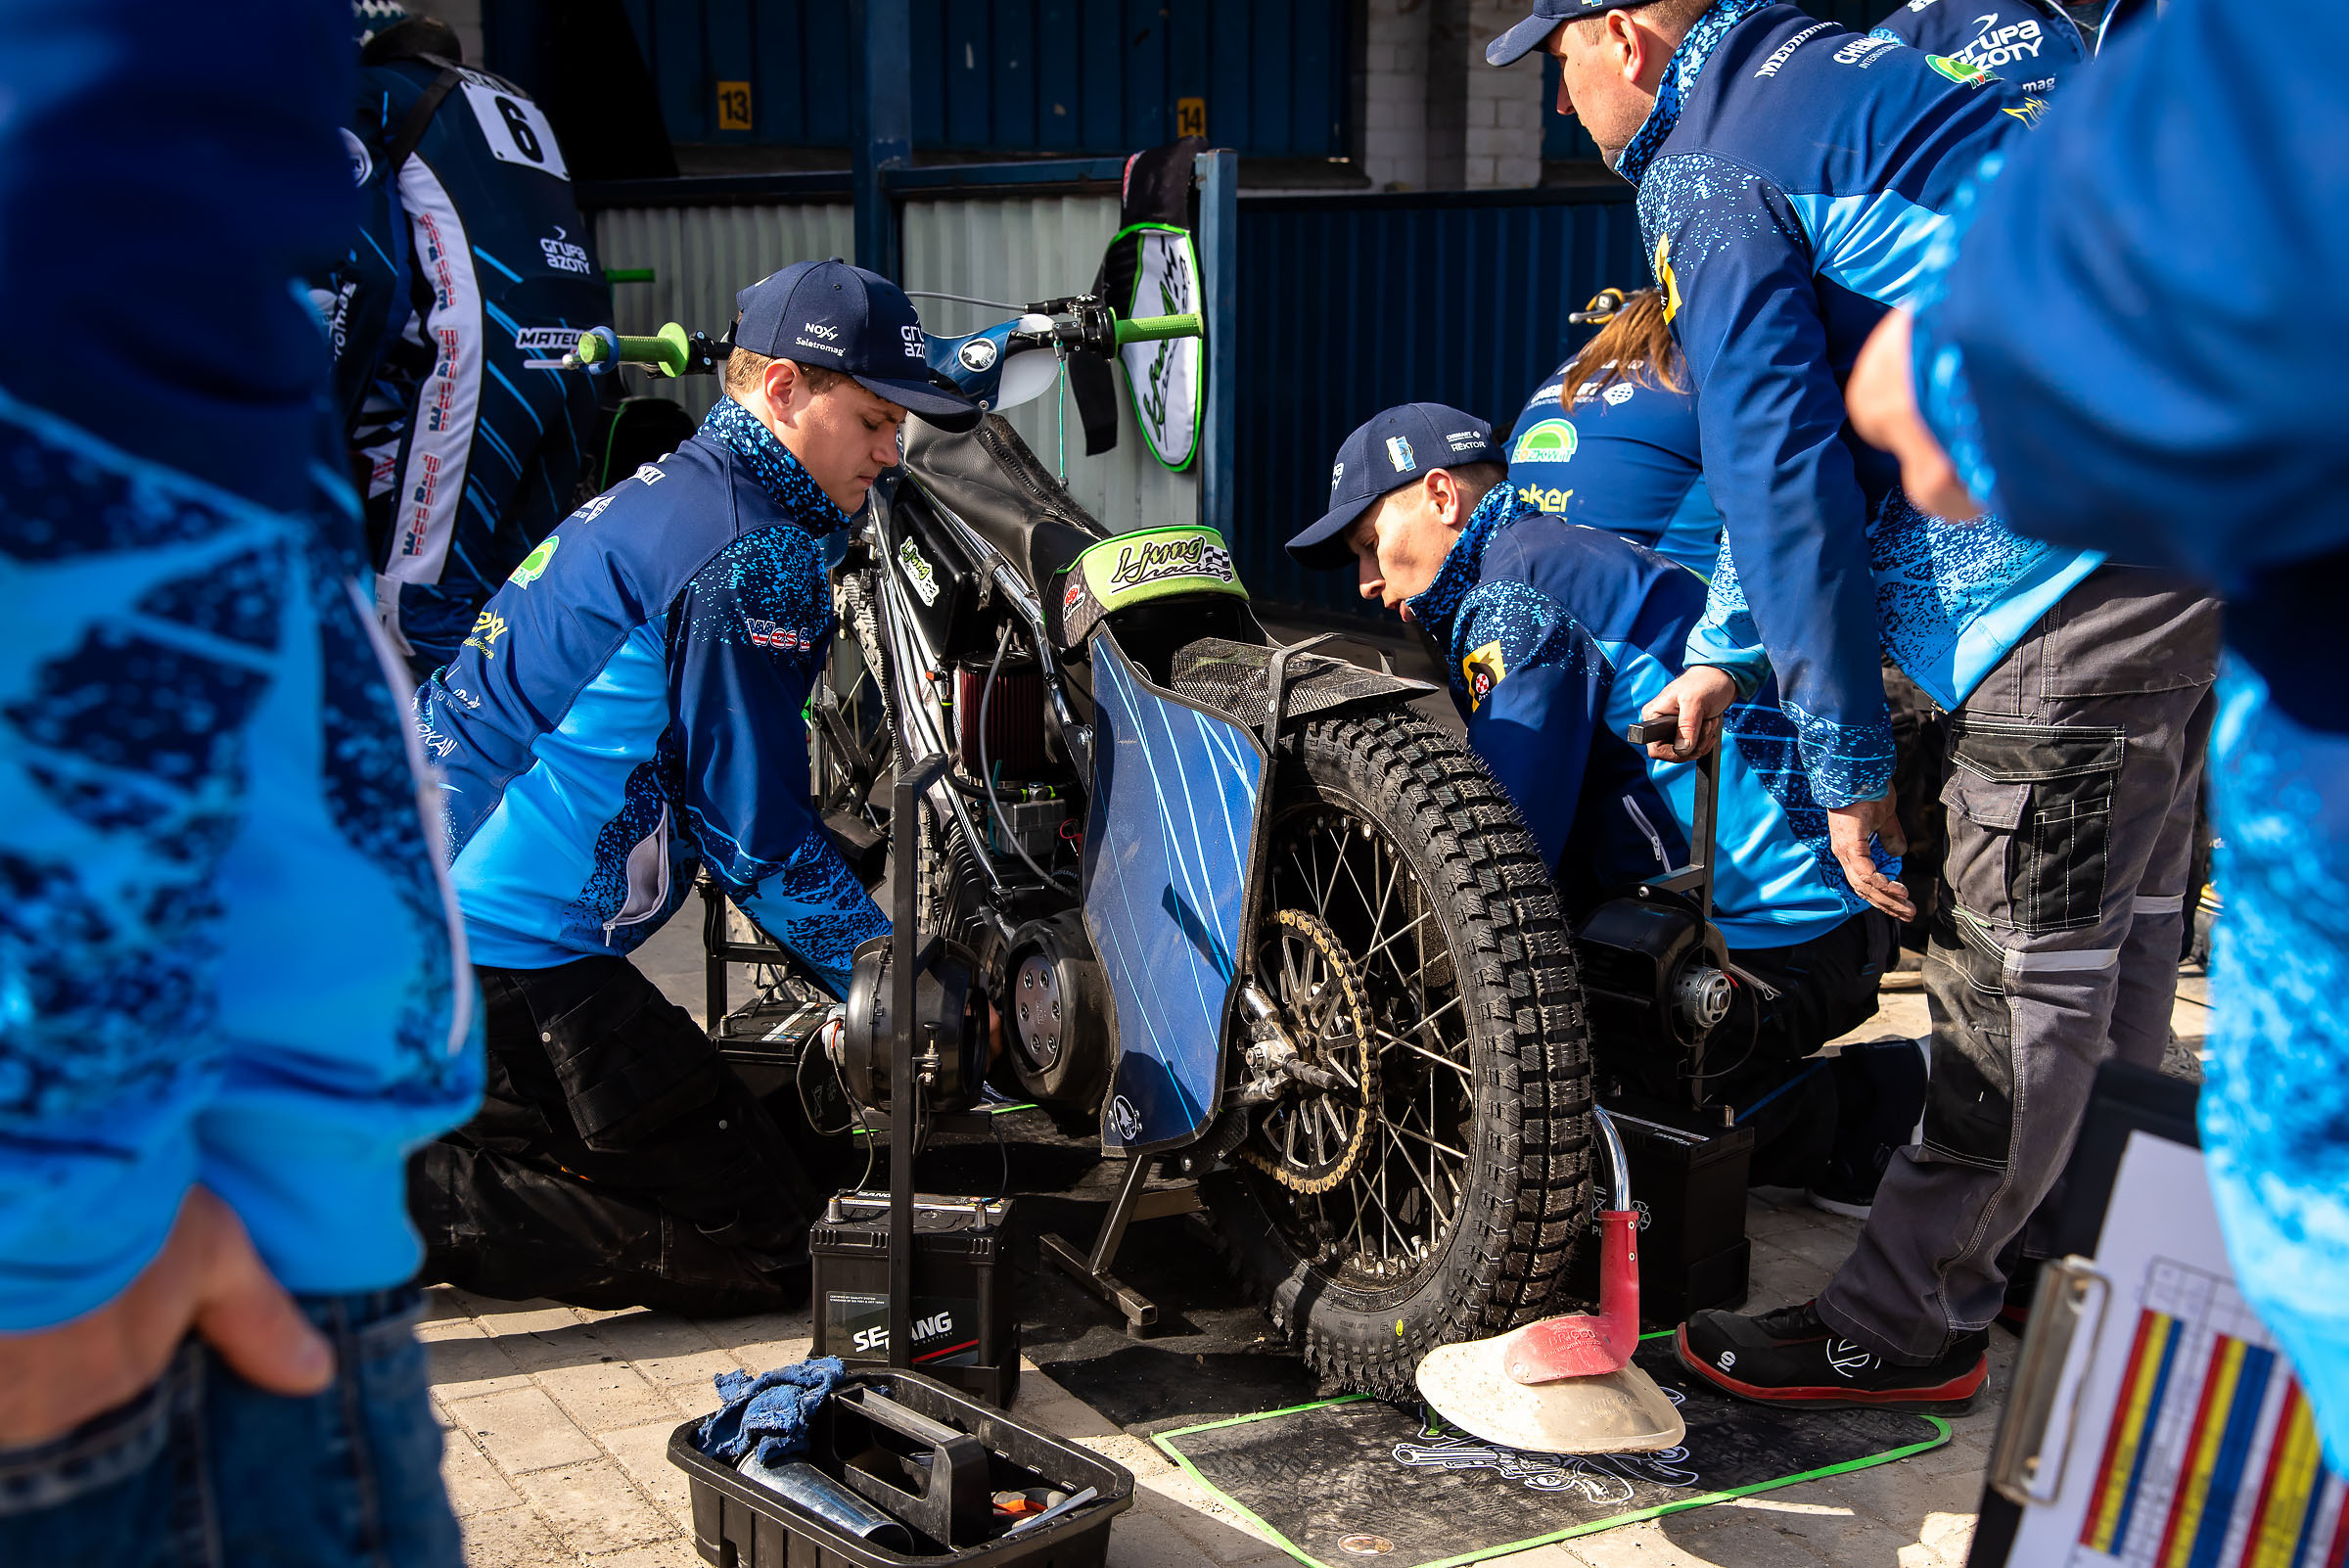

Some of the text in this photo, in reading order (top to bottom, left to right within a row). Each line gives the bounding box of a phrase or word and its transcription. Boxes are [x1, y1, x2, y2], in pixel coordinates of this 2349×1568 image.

[720, 91, 749, 123] 13
[1178, 106, 1202, 133] 14
[494, 96, 544, 164] 6
[796, 337, 846, 357] Saletromag
[1518, 483, 1574, 513] aker
